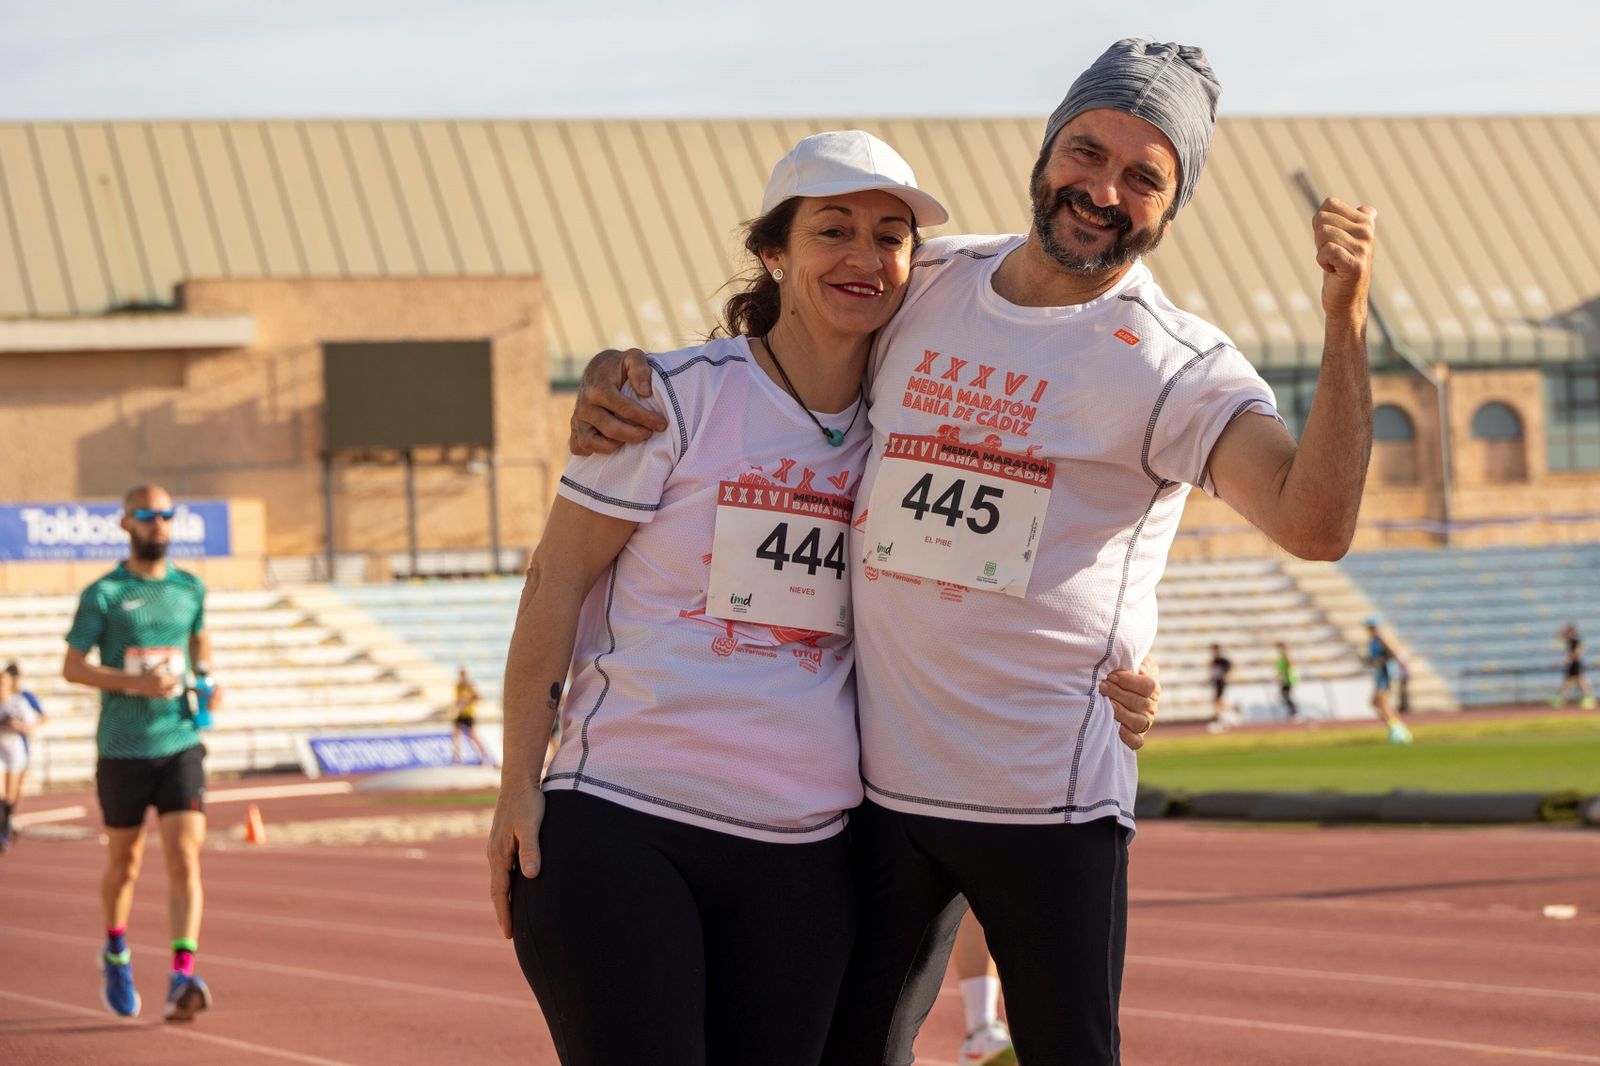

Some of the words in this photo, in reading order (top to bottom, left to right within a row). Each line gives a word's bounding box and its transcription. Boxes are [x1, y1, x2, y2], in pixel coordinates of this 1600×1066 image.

[914, 350, 1049, 403] XXXVI
[906, 376, 953, 400] MEDIA
[956, 388, 1037, 422] MARATÓN
[952, 405, 975, 422] DE
[975, 410, 1032, 437] CÁDIZ
[889, 437, 939, 459] XXXVI
[941, 444, 980, 459] MEDIA
[938, 452, 979, 468] BAHÍA
[982, 462, 1001, 473] DE
[1003, 466, 1049, 484] CÁDIZ
[723, 485, 790, 509] XXXVI
[792, 501, 830, 515] BAHÍA
[793, 492, 830, 506] MEDIA
[901, 472, 1005, 534] 445
[756, 522, 846, 580] 444
[877, 542, 894, 556] imd
[924, 535, 934, 544] EL
[935, 537, 952, 548] PIBE
[730, 593, 753, 607] imd
[789, 586, 816, 596] NIEVES
